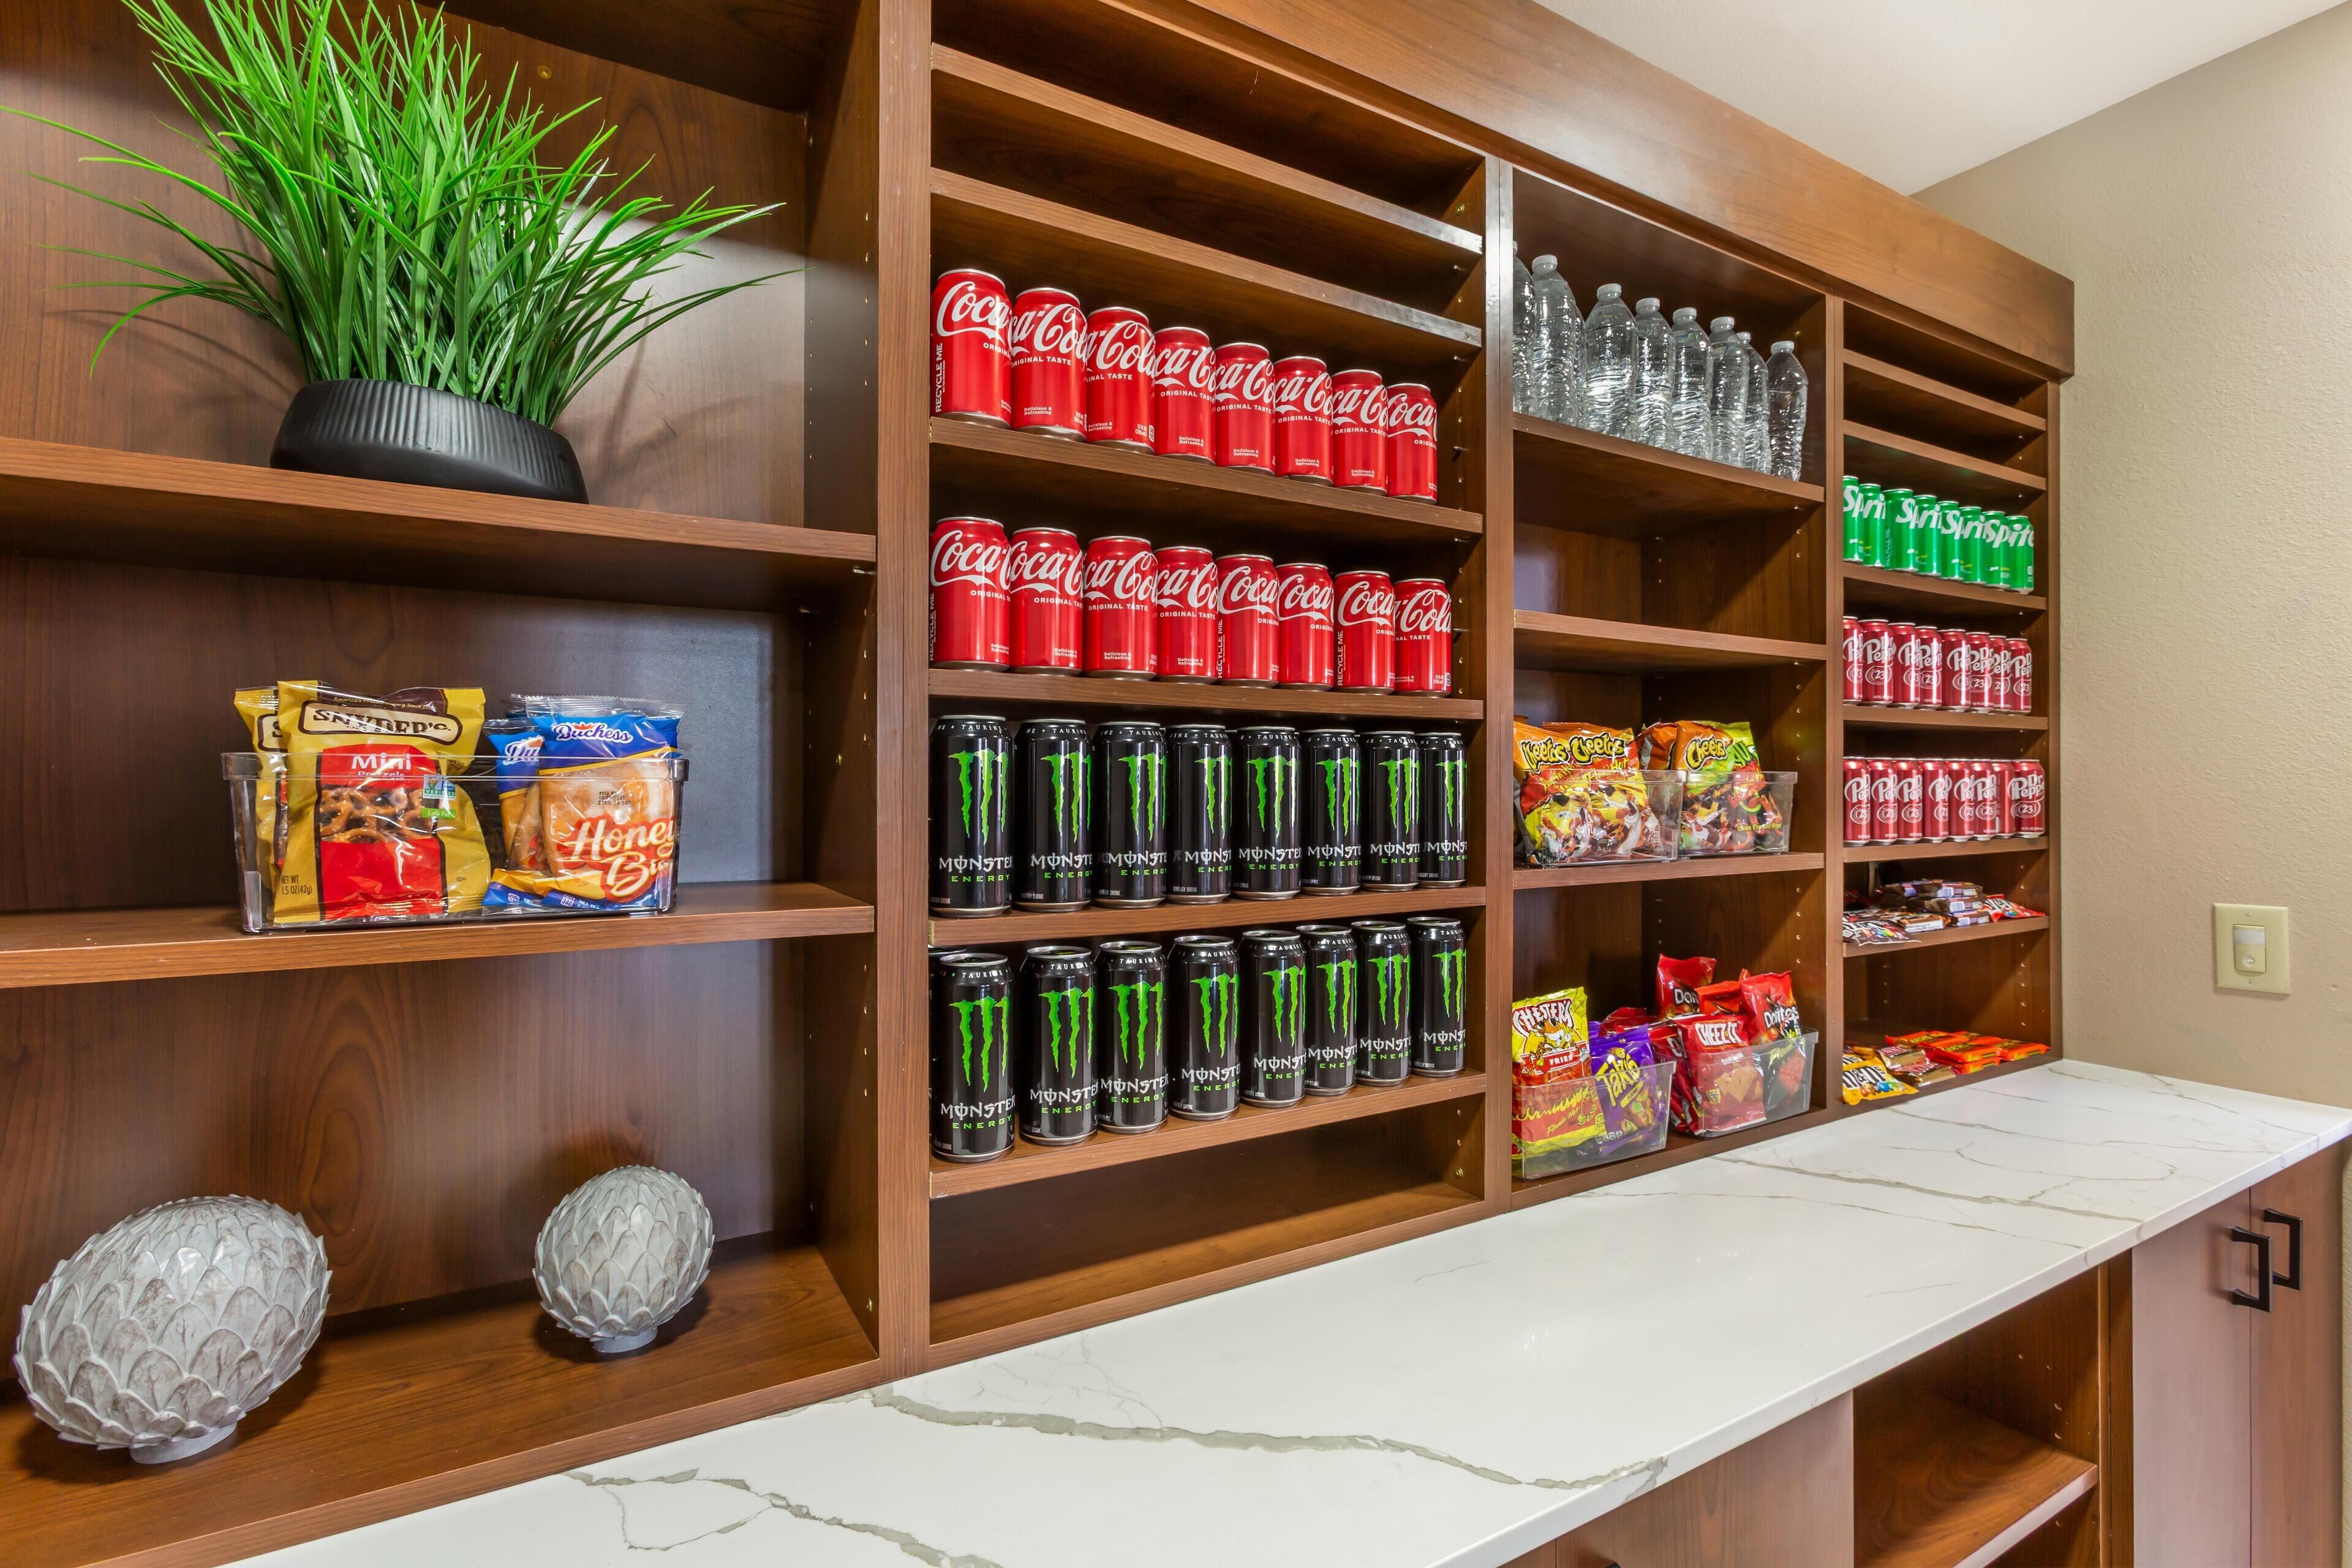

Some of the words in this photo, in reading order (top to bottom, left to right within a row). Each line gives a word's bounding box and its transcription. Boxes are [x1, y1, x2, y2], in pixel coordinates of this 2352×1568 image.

[936, 343, 943, 361] ME
[1046, 356, 1072, 366] TASTE
[1254, 405, 1272, 415] TASTE
[1315, 417, 1330, 426] TASTE
[1370, 428, 1385, 437] TASTE
[930, 592, 935, 610] ME
[970, 590, 1006, 600] ORIGINAL
[1034, 597, 1072, 606] ORIGINAL
[1218, 619, 1223, 634] ME
[1338, 631, 1343, 644] ME
[554, 722, 631, 742] Duchess
[1569, 732, 1627, 764] Cheetos
[351, 752, 412, 771] Mini
[2027, 774, 2043, 787] Dr
[2022, 805, 2034, 813] 23
[564, 819, 674, 857] Honey
[1308, 844, 1361, 858] MONSTE
[1427, 840, 1467, 854] MONST
[1031, 852, 1093, 869] MONSTE
[1107, 850, 1167, 867] MONSTE
[1185, 848, 1232, 865] MONST
[290, 875, 299, 884] WT
[1423, 1029, 1466, 1044] MONST
[1360, 1036, 1411, 1052] MONSTE
[1550, 1054, 1573, 1066] FRIES
[1181, 1066, 1240, 1084] MONSTE
[1595, 1054, 1641, 1106] Takis
[1101, 1072, 1169, 1095] MONSTER
[1111, 1091, 1165, 1102] ENERGY
[941, 1094, 1015, 1120] MONSTER
[1041, 1101, 1096, 1114] ENERGY
[952, 1116, 1011, 1129] ENERGY
